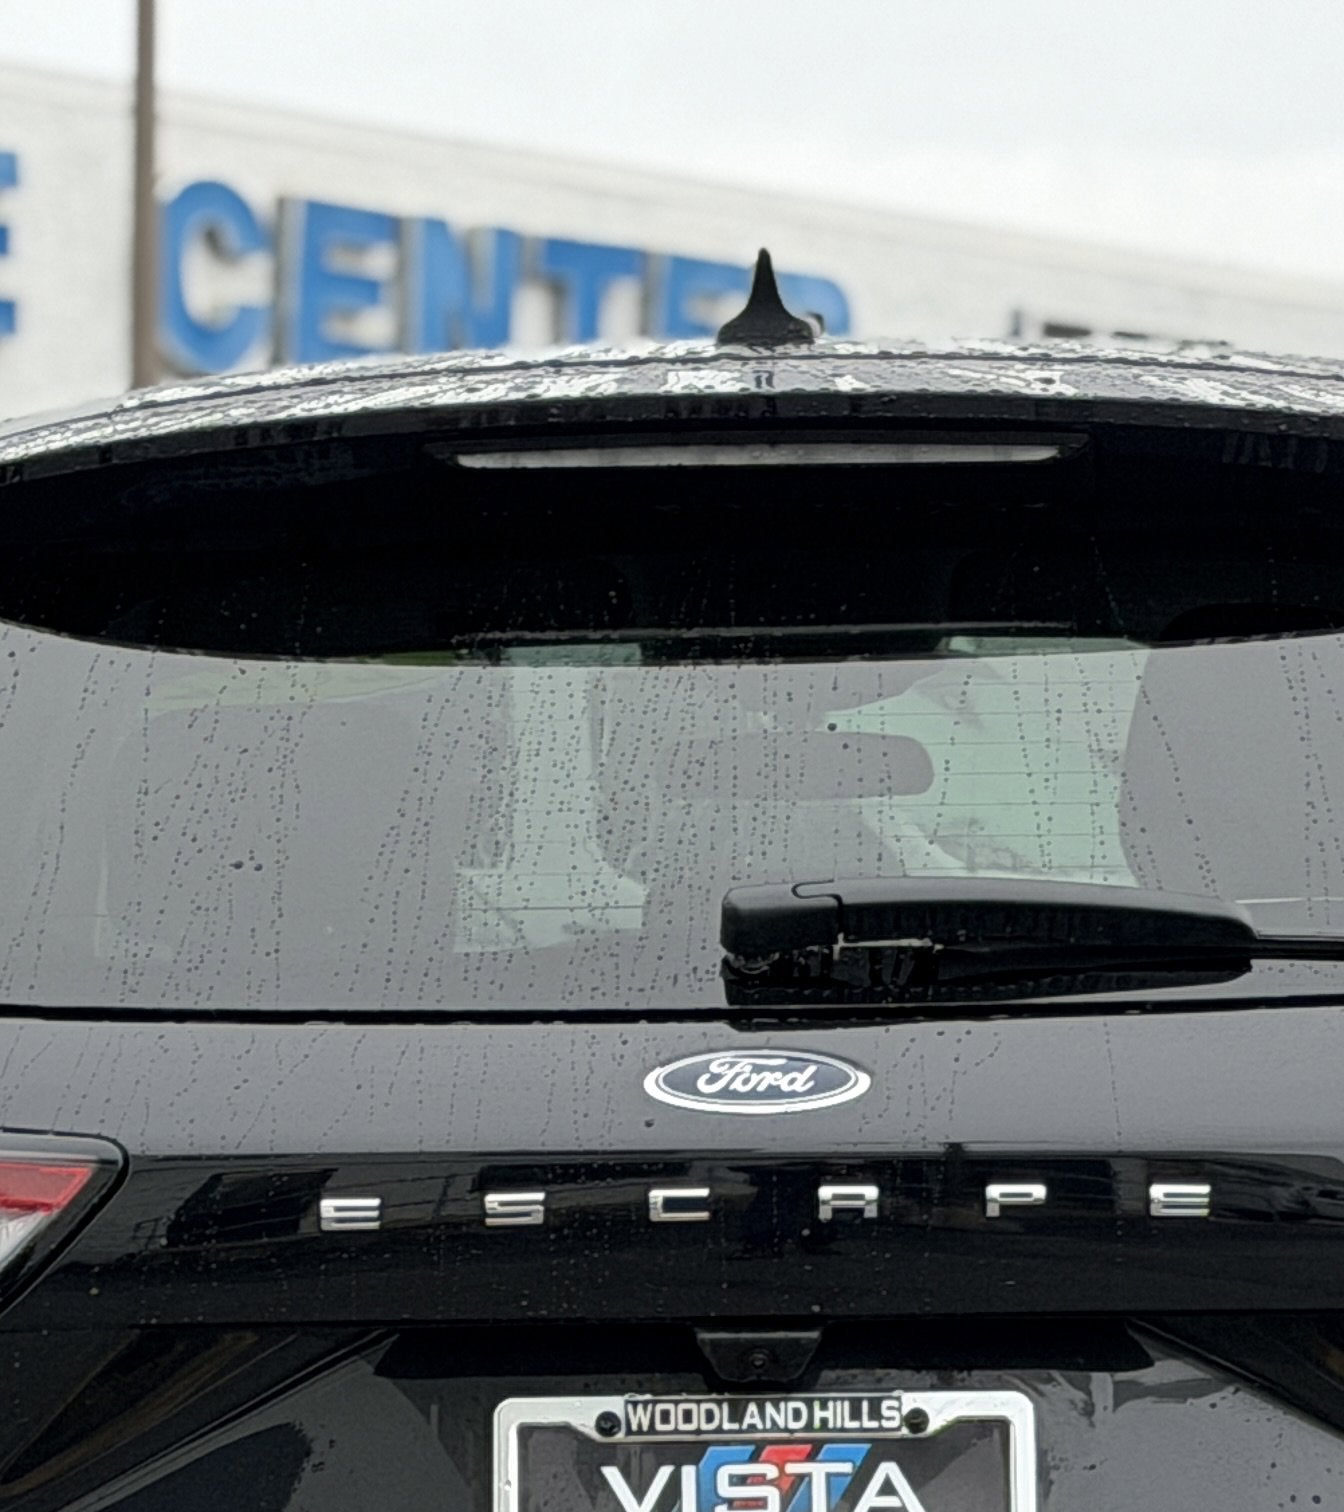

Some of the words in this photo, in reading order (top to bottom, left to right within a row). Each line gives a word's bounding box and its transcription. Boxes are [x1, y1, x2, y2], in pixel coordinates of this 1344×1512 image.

[696, 1056, 818, 1094] Ford
[319, 1184, 1213, 1233] ESCAPE
[627, 1401, 808, 1432] WOODLAND
[813, 1400, 901, 1429] HILLS
